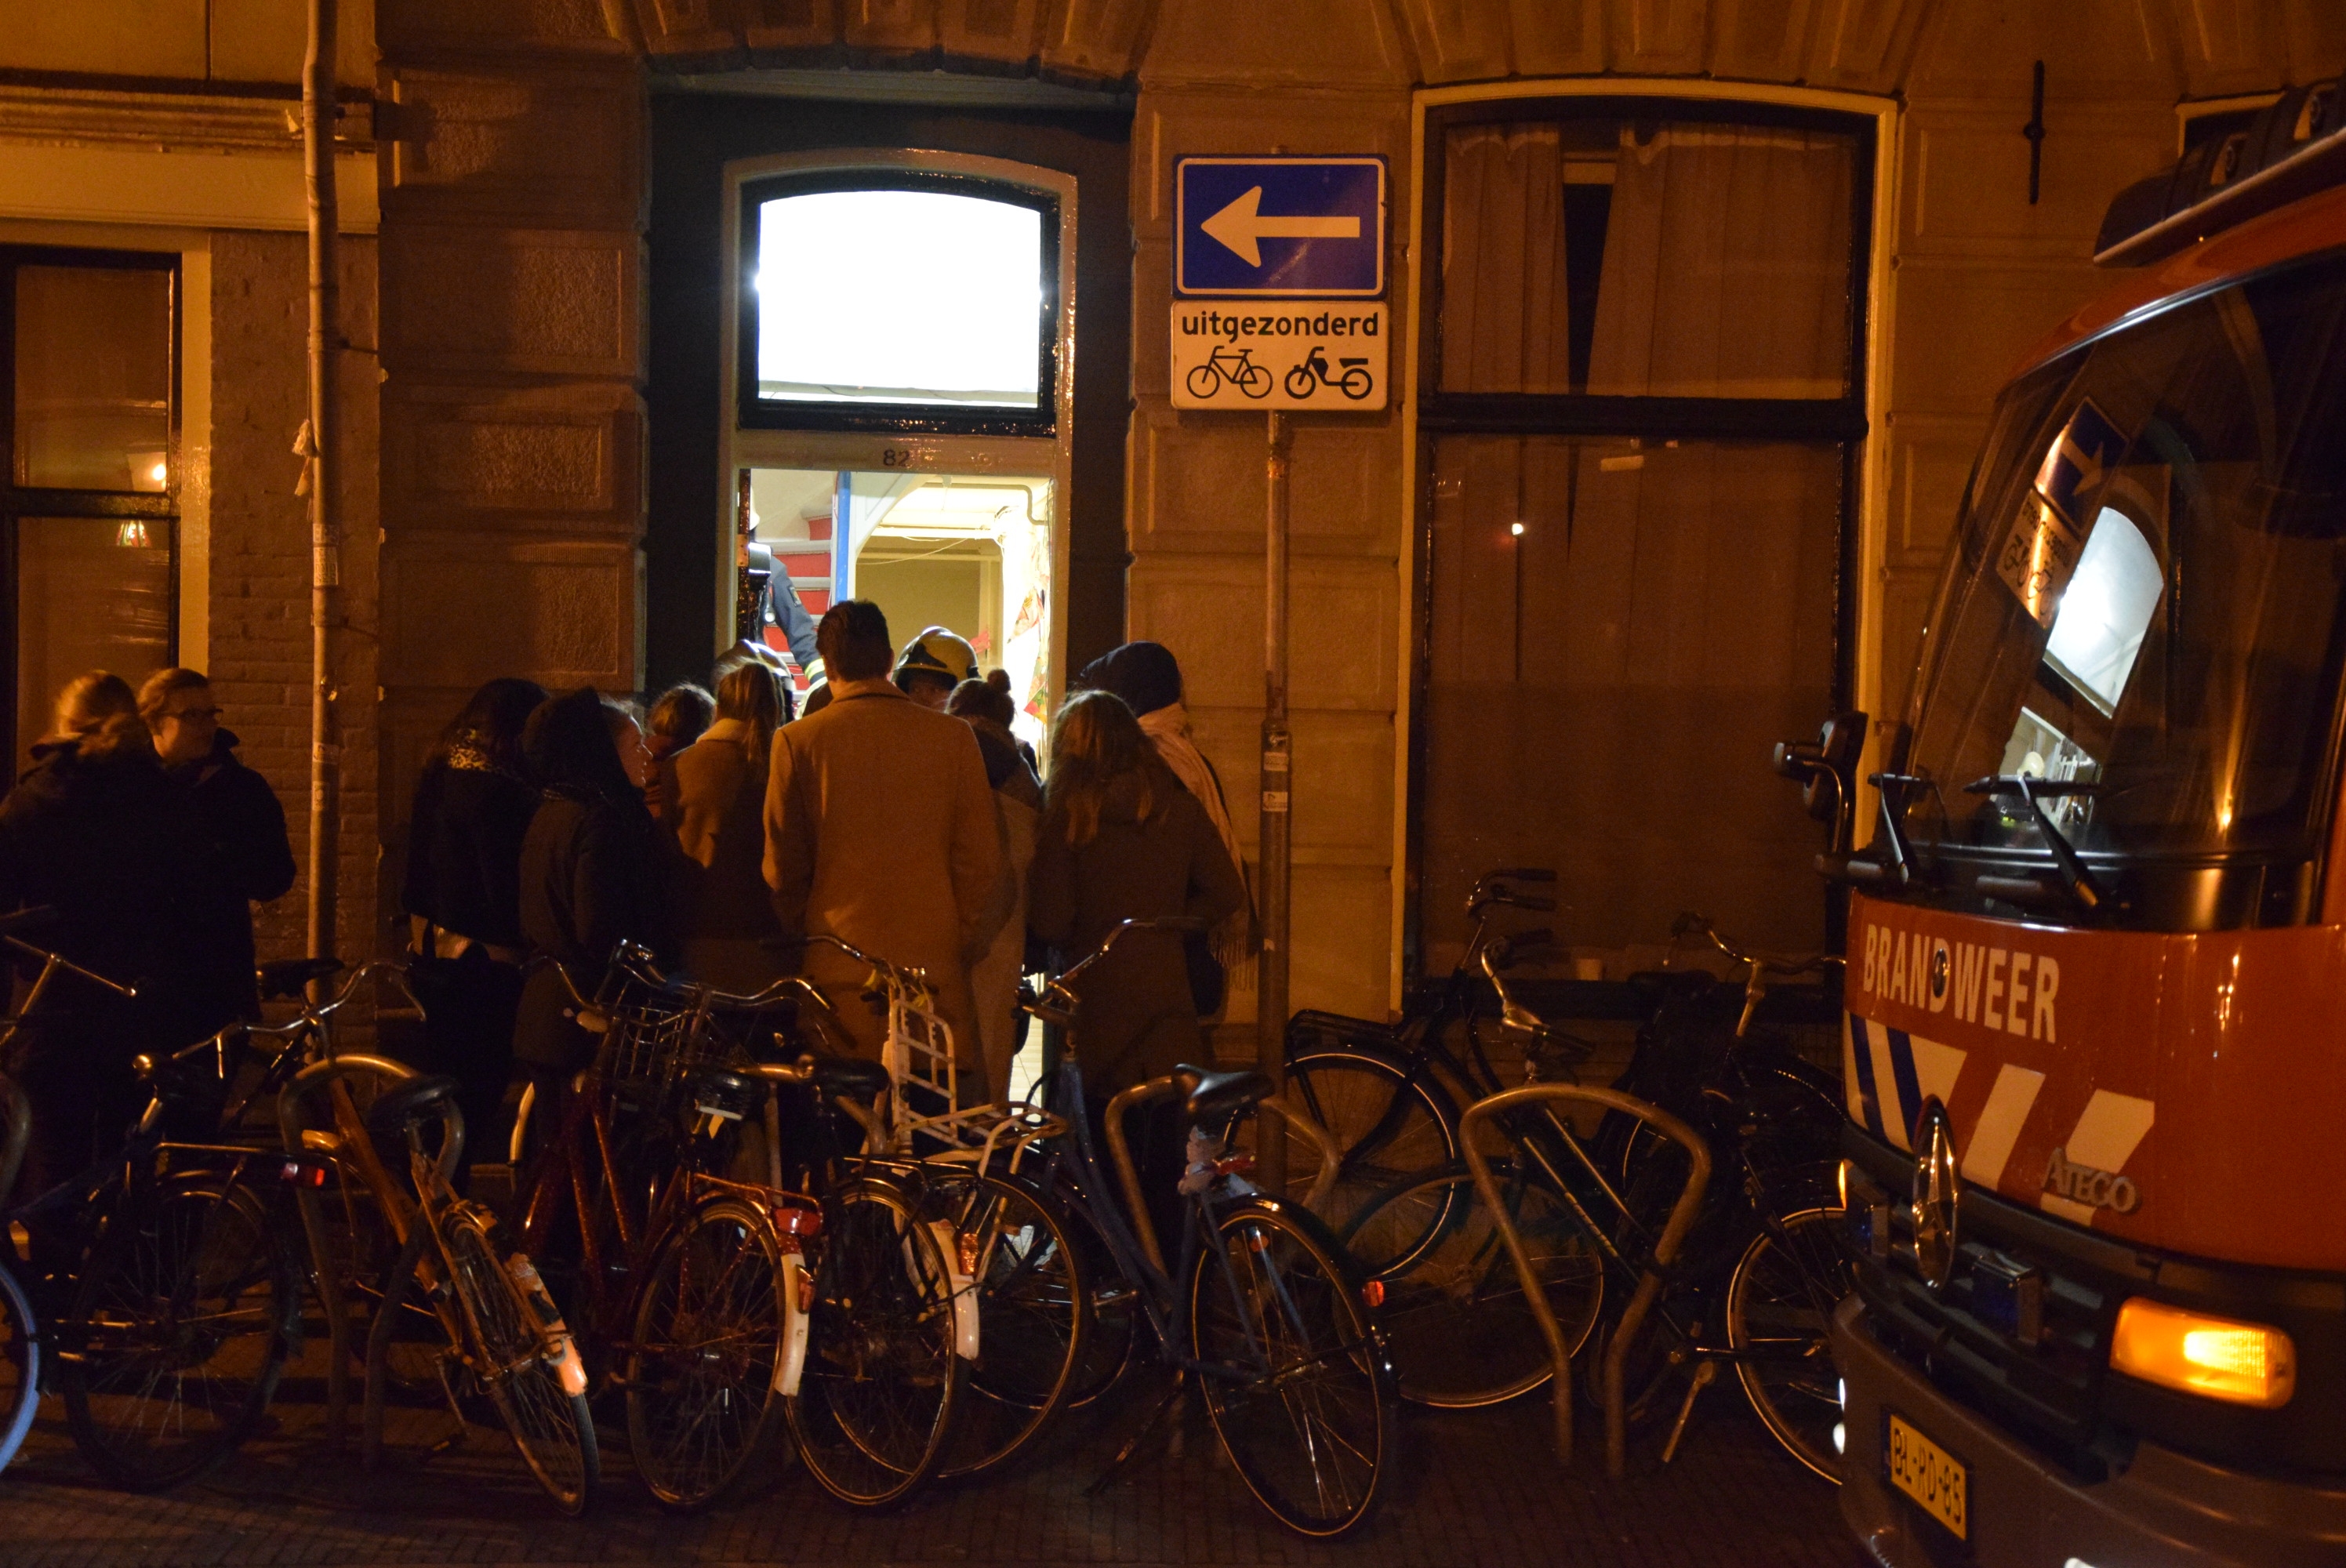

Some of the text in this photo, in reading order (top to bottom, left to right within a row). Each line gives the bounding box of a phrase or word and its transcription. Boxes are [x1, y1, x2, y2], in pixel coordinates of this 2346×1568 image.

[1182, 310, 1378, 343] uitgezonderd
[883, 449, 910, 467] 82
[1862, 923, 2061, 1044] BRANDWEER
